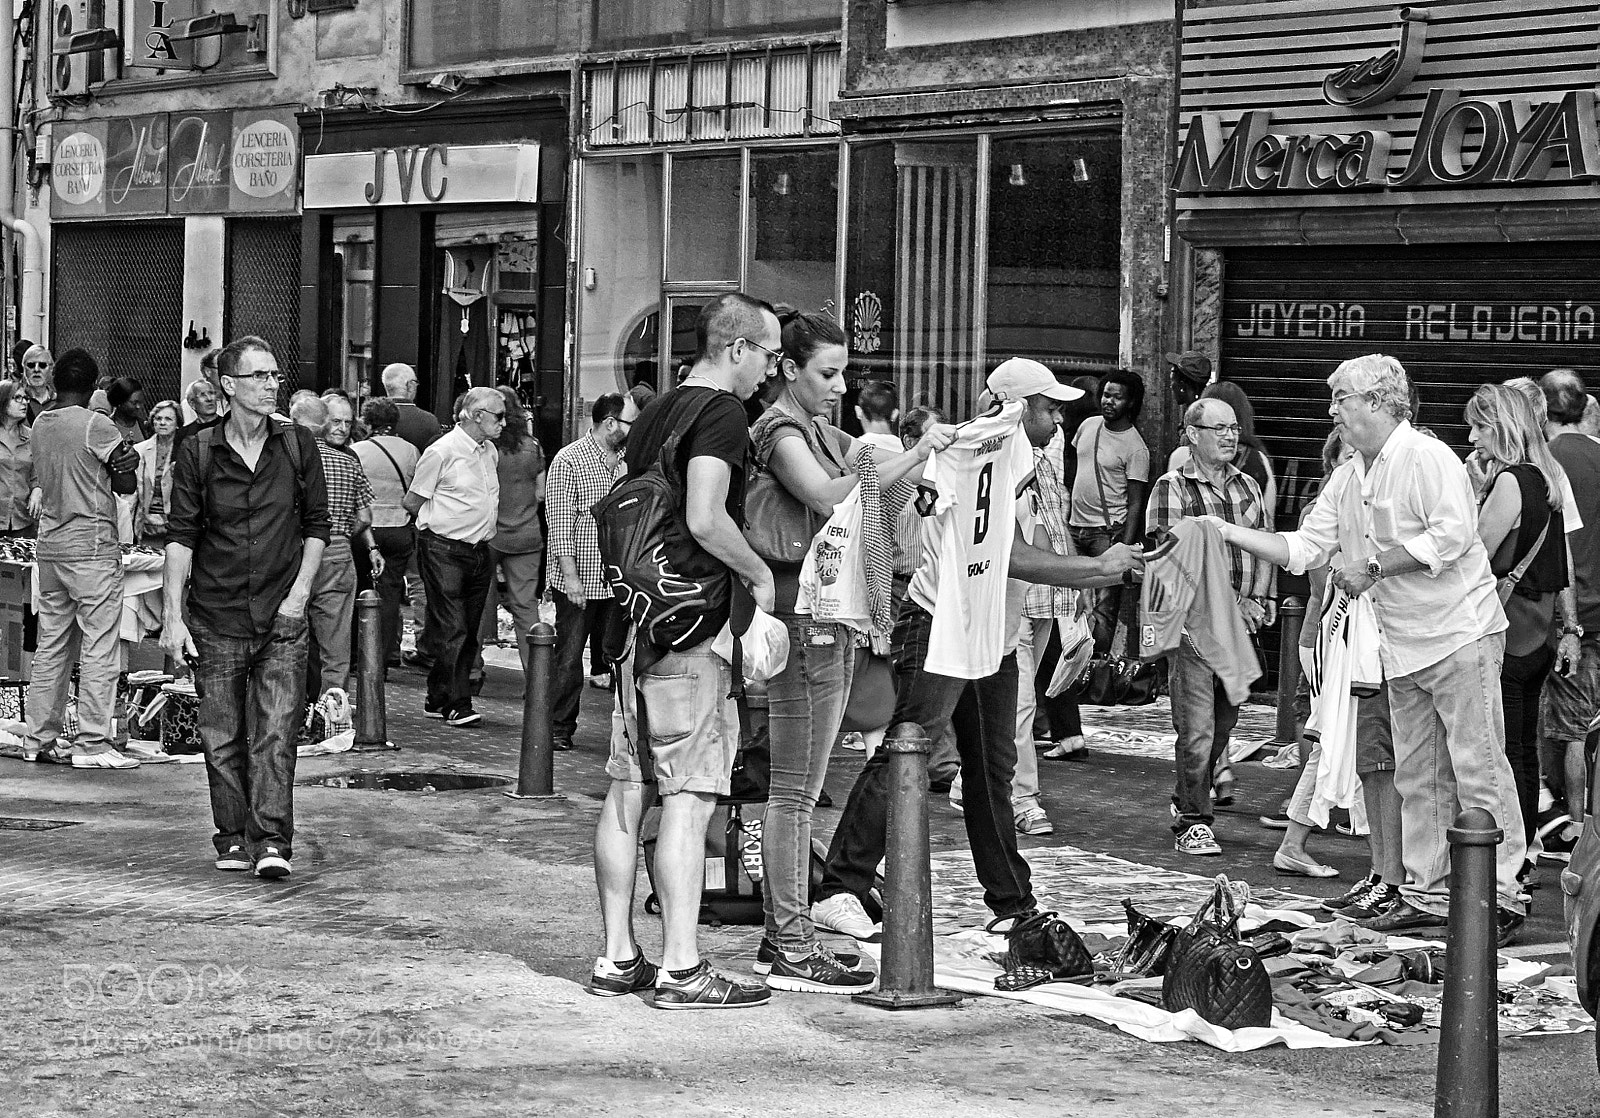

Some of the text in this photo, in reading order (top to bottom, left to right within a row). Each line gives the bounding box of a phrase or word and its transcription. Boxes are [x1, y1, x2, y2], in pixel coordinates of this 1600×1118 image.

[60, 143, 98, 159] LENCERIA
[235, 150, 293, 169] CORSETERIA
[241, 131, 288, 149] LENCERIA
[1169, 88, 1598, 192] Merca JOYA
[249, 169, 278, 188] BAÑO
[364, 143, 448, 205] JVC
[973, 461, 993, 546] 9
[743, 819, 764, 878] SPORT
